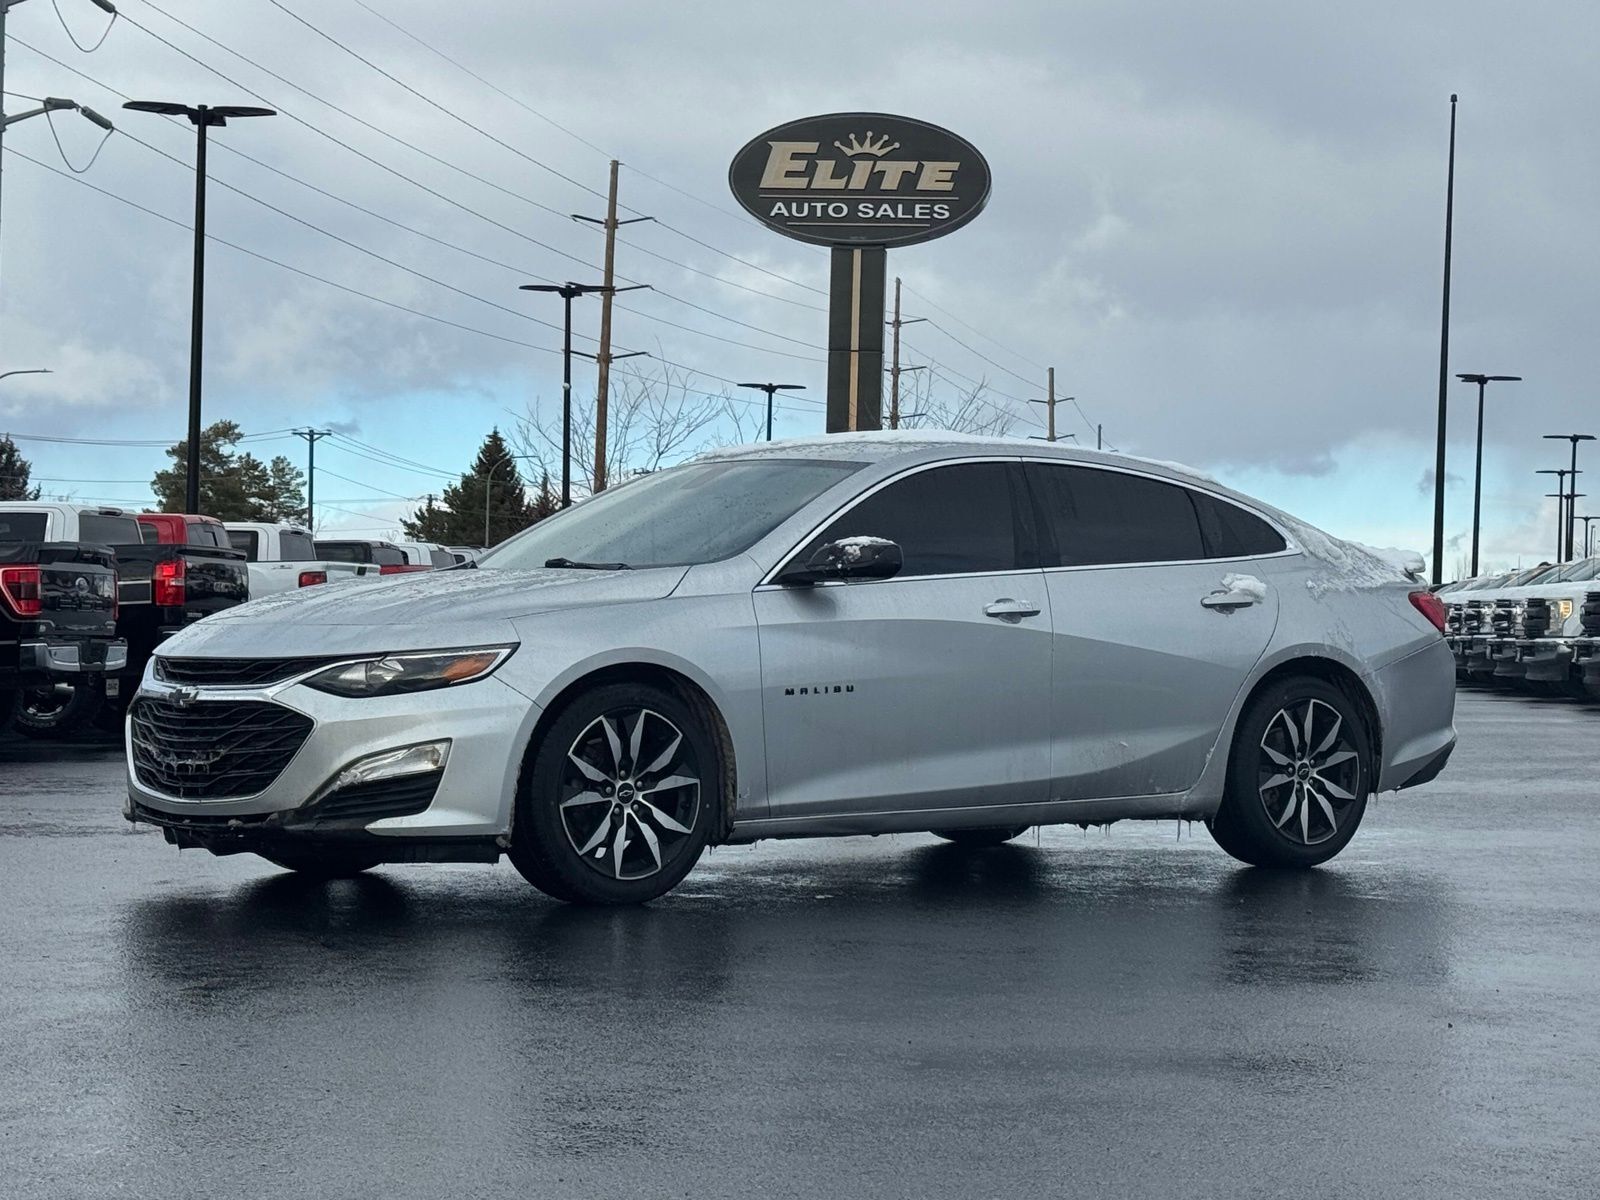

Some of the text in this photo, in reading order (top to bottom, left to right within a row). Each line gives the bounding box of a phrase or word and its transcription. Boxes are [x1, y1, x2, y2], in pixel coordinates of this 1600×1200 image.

[759, 141, 960, 191] ELITE
[769, 201, 950, 219] AUTO SALES
[784, 684, 854, 696] MALIBU
